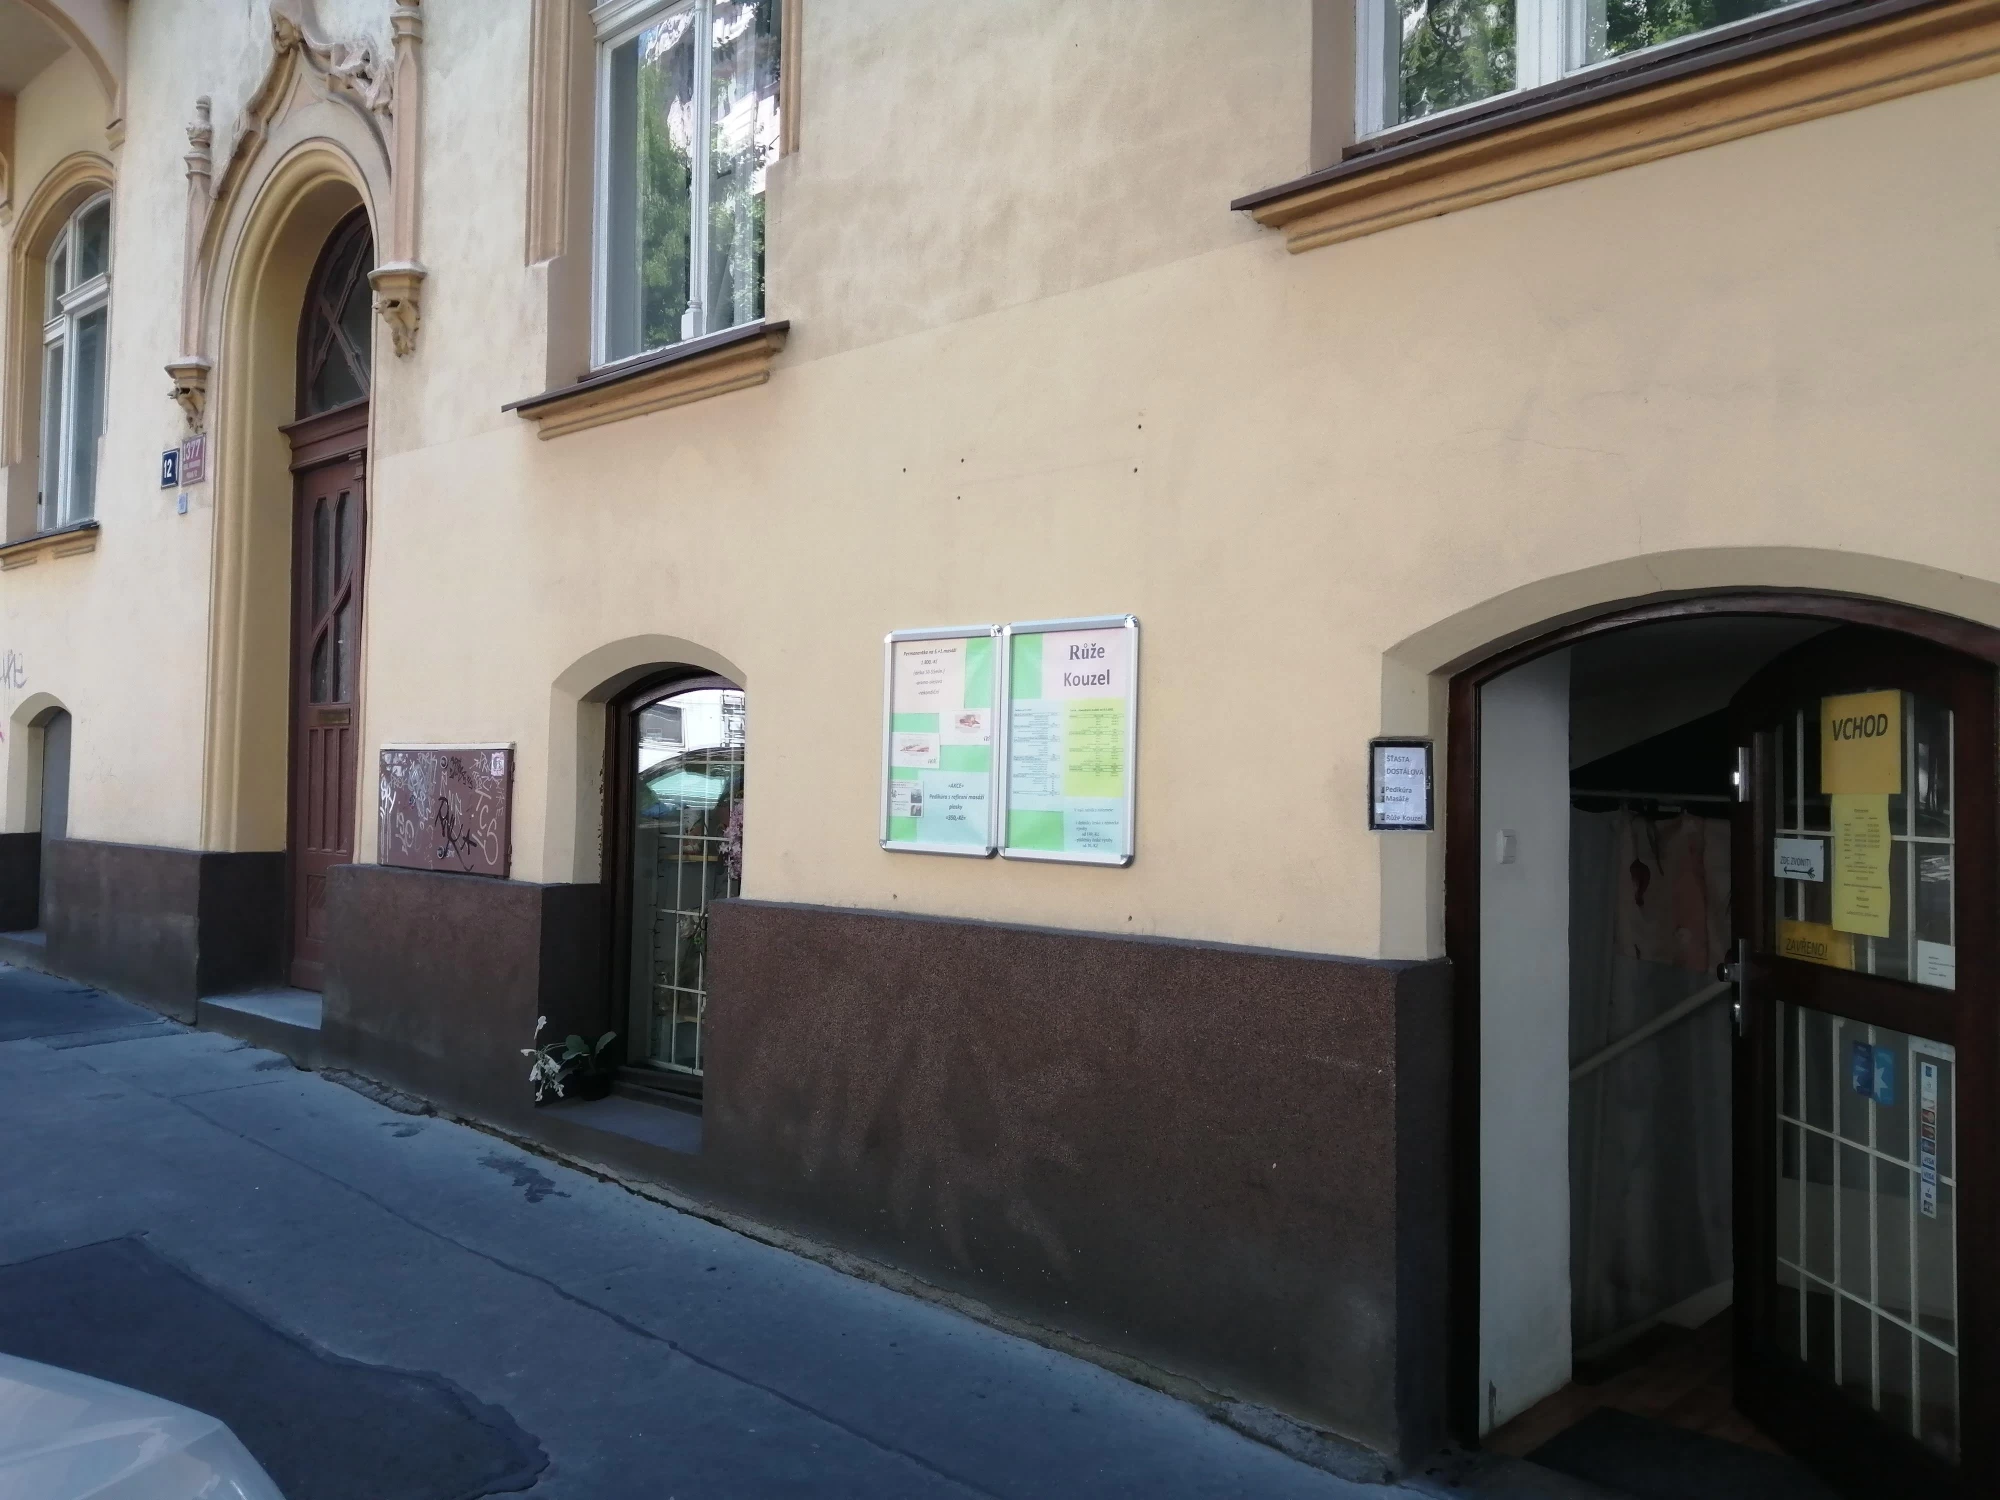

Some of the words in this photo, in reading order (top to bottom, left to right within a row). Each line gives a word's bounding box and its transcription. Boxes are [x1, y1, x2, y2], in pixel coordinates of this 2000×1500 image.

[183, 438, 201, 462] 1377
[164, 459, 172, 478] 12
[1069, 642, 1105, 661] Růže
[1063, 669, 1110, 687] Kouzel
[1832, 713, 1889, 742] VCHOD
[1386, 767, 1424, 776] DOSTÁLOVÁ
[1385, 786, 1413, 794] Pedikúra
[1402, 814, 1424, 823] Kouzel
[1785, 938, 1828, 956] ZAVŘENO!
